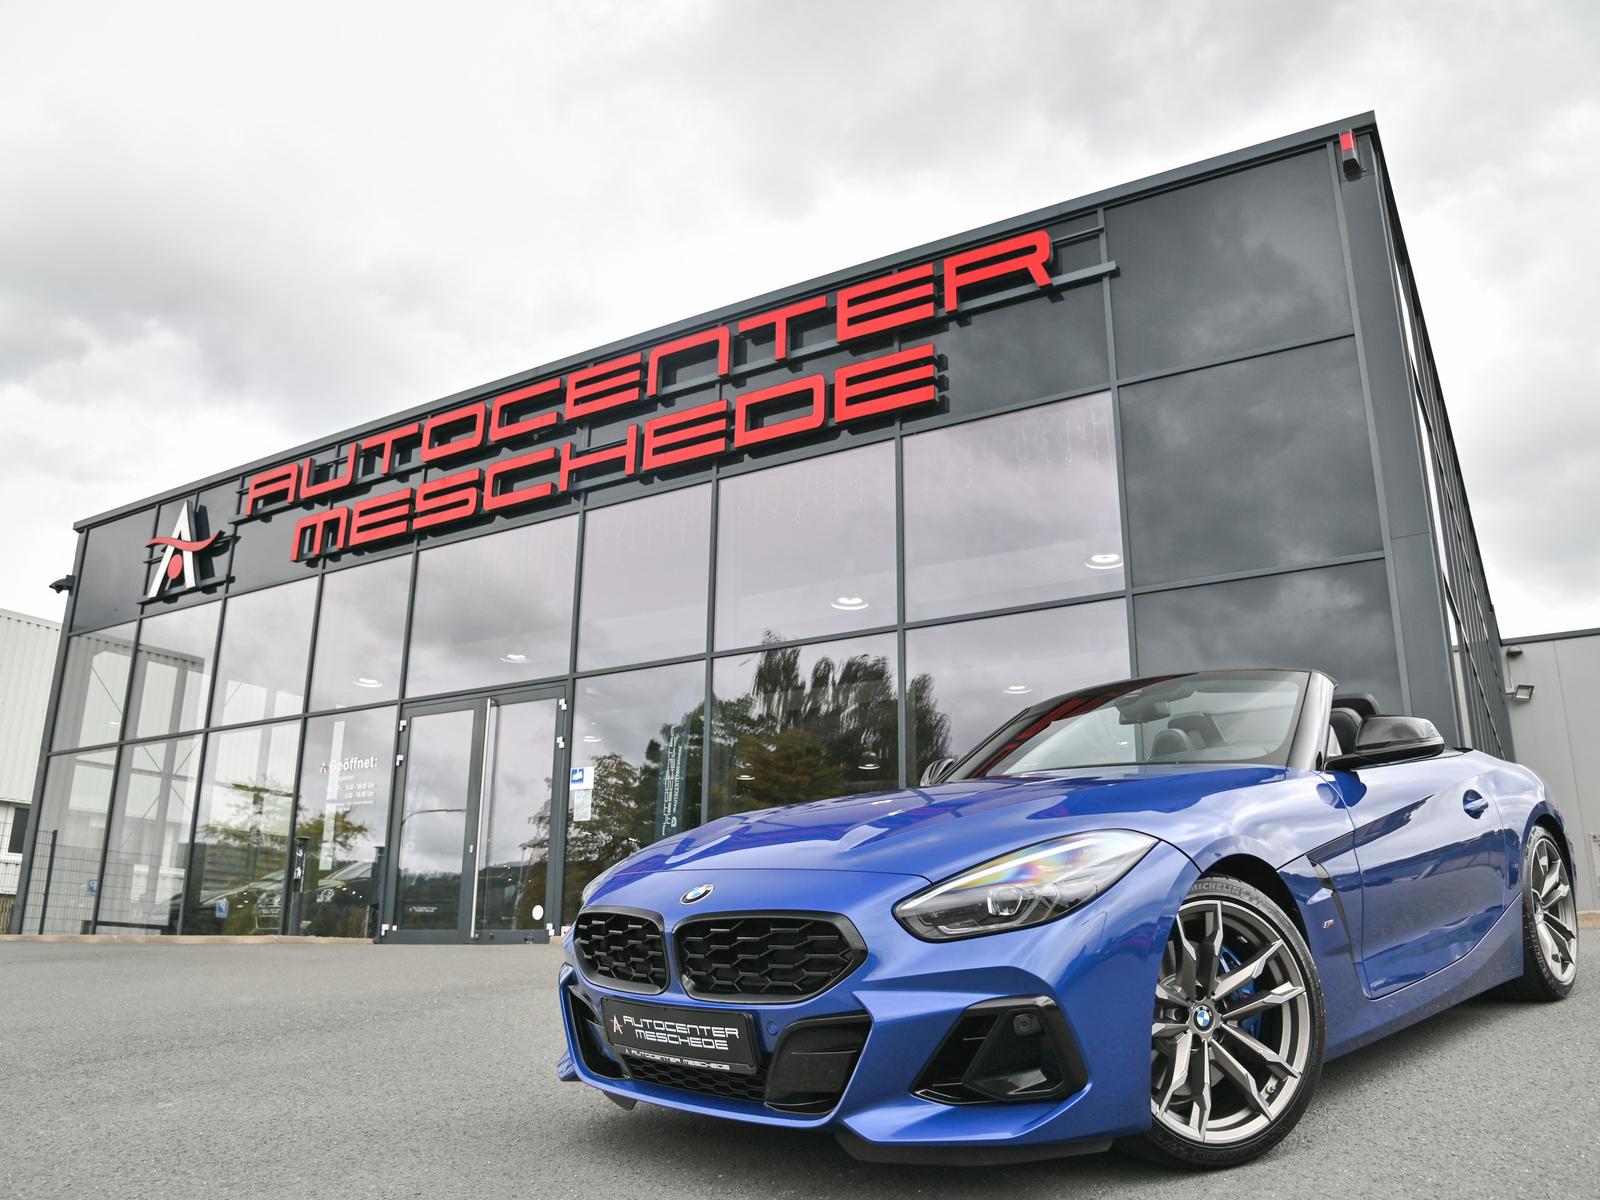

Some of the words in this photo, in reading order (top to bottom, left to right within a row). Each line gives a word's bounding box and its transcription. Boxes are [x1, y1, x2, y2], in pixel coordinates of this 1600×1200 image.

[245, 230, 1053, 517] AUTOCENTER
[290, 343, 936, 563] MESCHEDE
[623, 1016, 739, 1038] AUTOCENTER
[635, 1029, 728, 1050] MESCHEDE
[631, 1050, 682, 1063] AUTOCENTER
